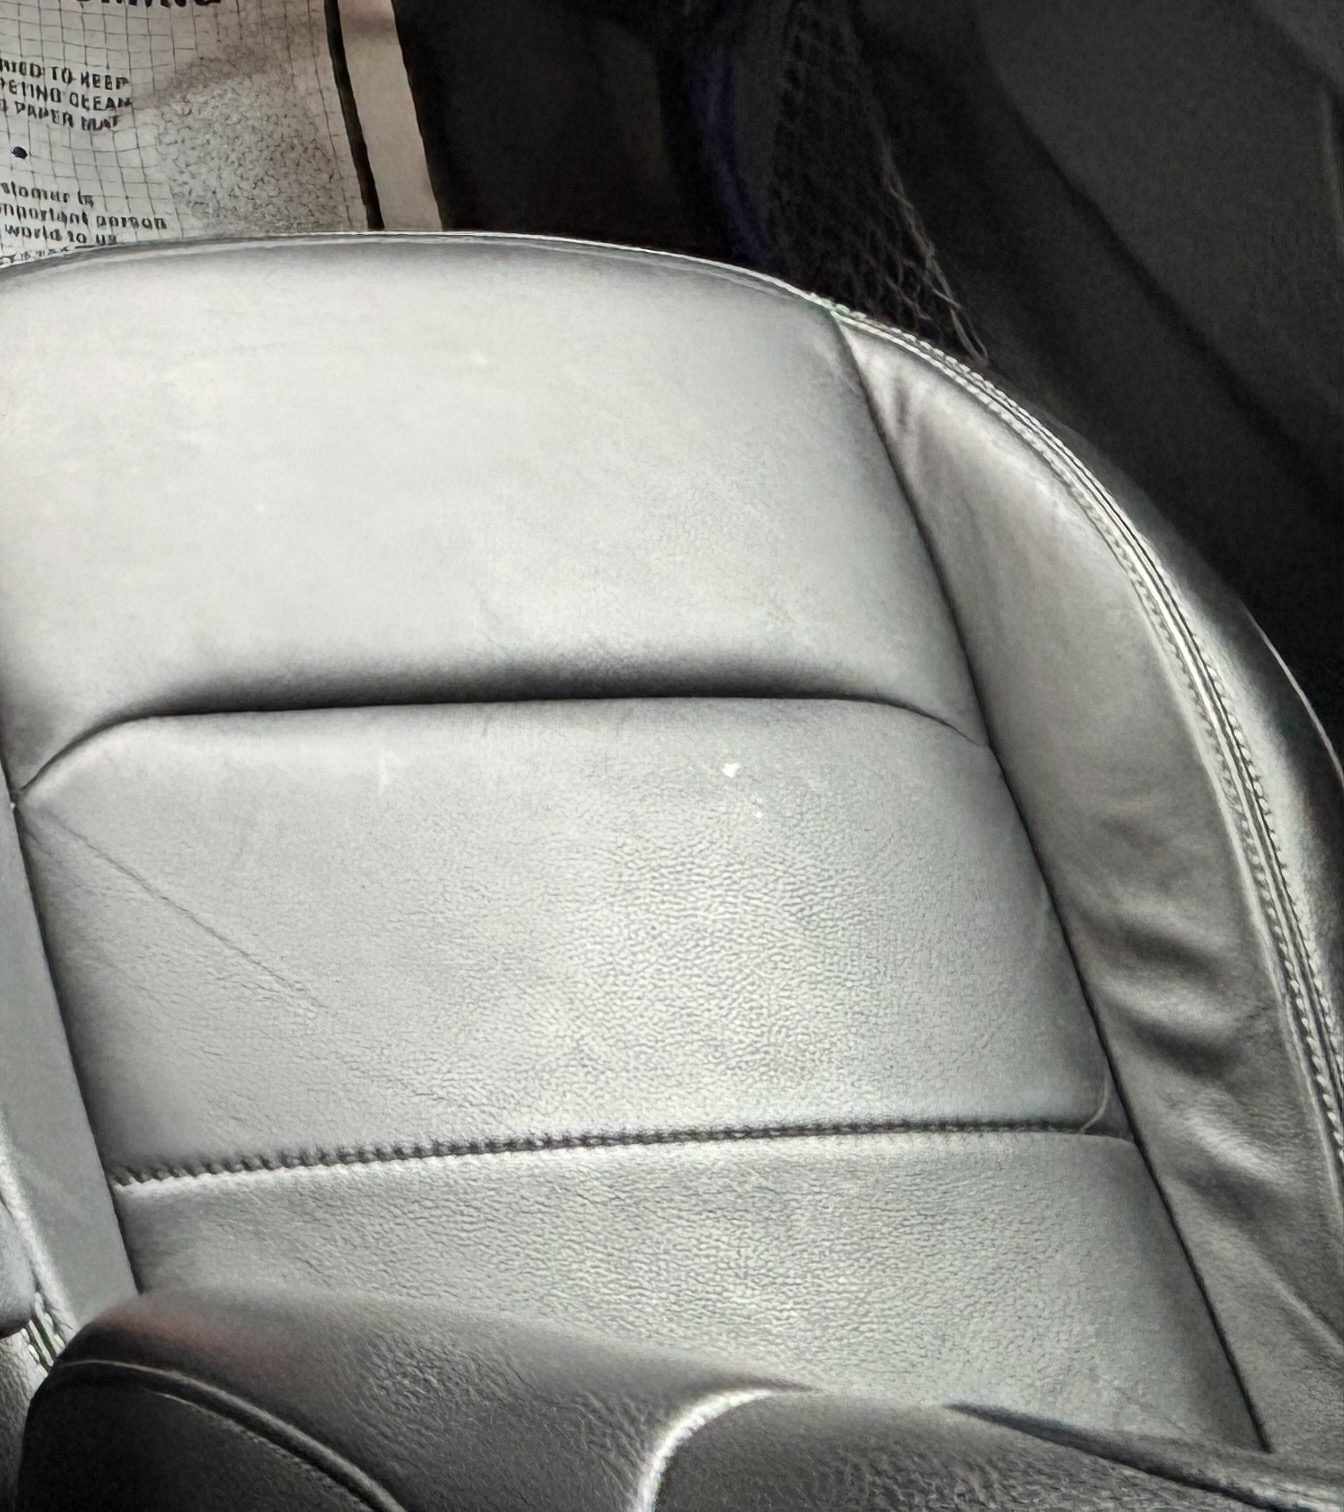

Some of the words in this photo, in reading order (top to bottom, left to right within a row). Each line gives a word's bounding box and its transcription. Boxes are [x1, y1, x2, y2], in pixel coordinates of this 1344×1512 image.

[52, 65, 74, 85] TO
[80, 71, 129, 90] KEEP
[69, 91, 134, 110] CLEAN
[15, 101, 74, 129] PAPER
[96, 214, 168, 231] person
[5, 223, 62, 242] world
[68, 231, 88, 245] to
[95, 234, 118, 247] us
